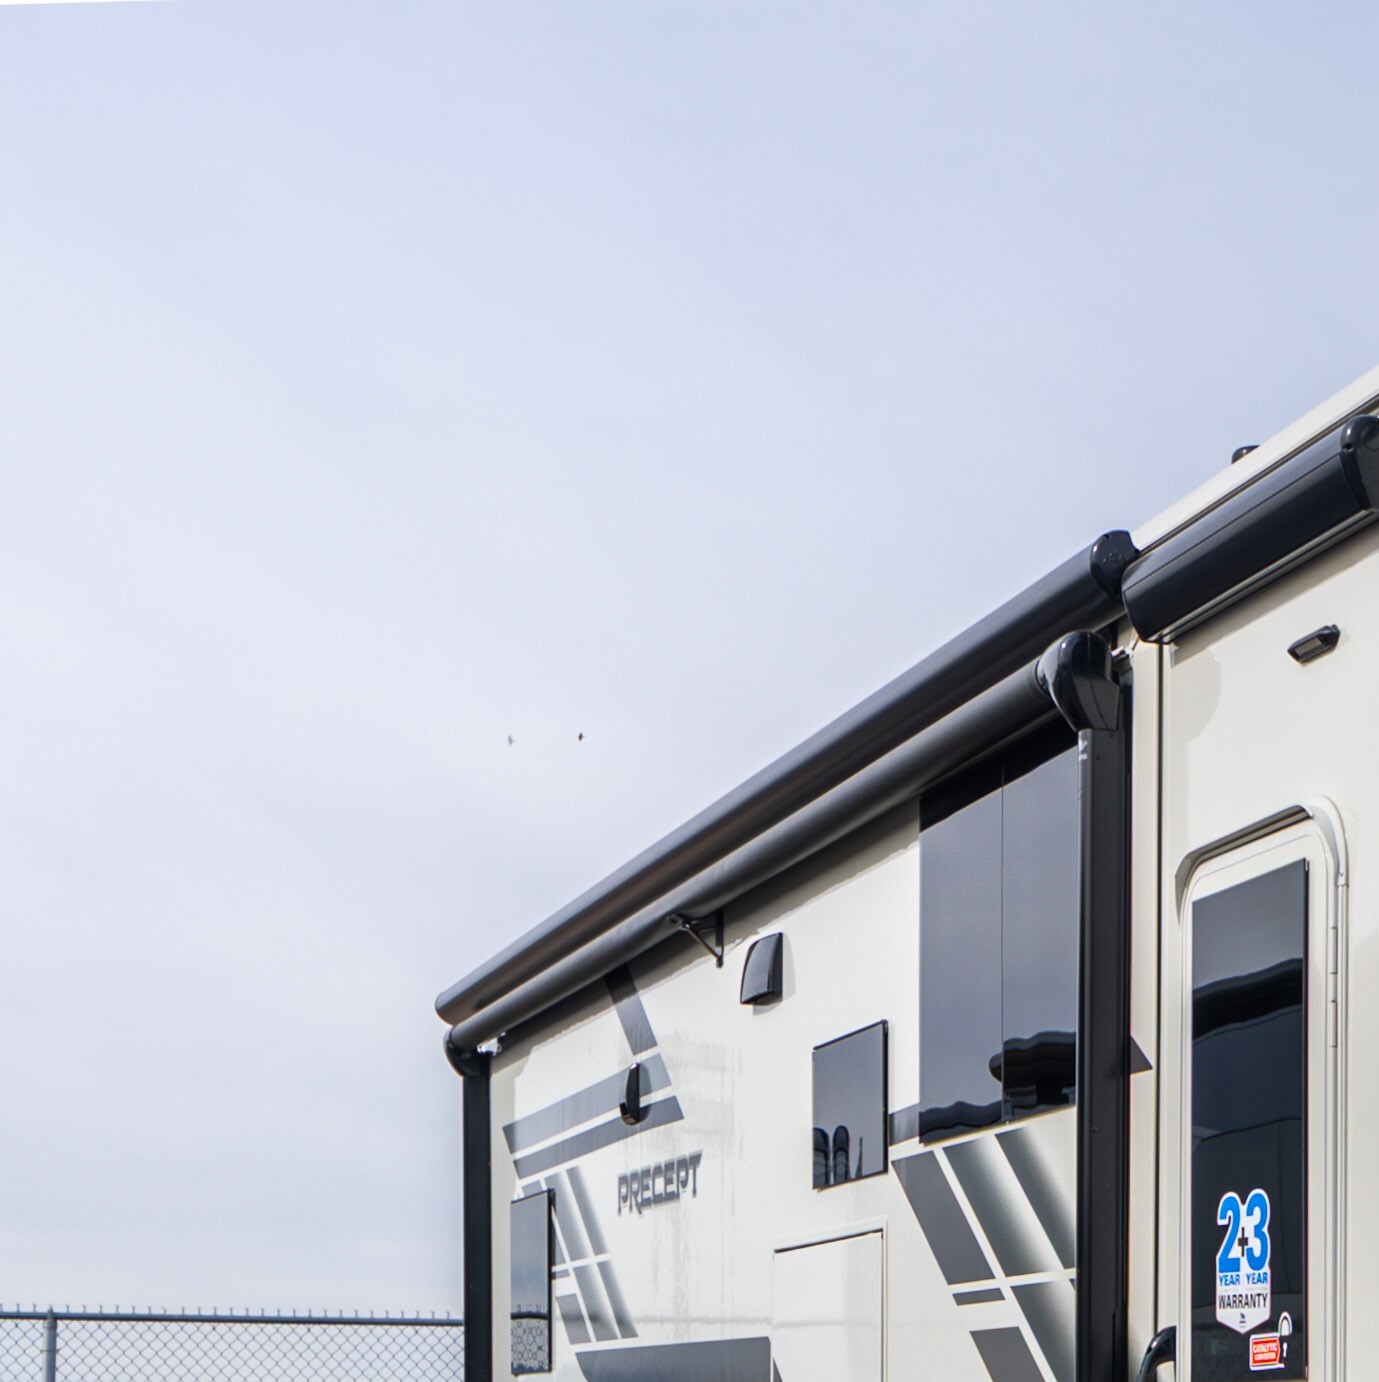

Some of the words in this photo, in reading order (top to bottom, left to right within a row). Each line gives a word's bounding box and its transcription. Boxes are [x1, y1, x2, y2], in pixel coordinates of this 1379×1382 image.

[617, 1150, 703, 1217] PRECEPT
[1218, 1274, 1241, 1287] YEAR
[1245, 1271, 1268, 1285] YEAR
[1218, 1292, 1268, 1310] WARRANTY
